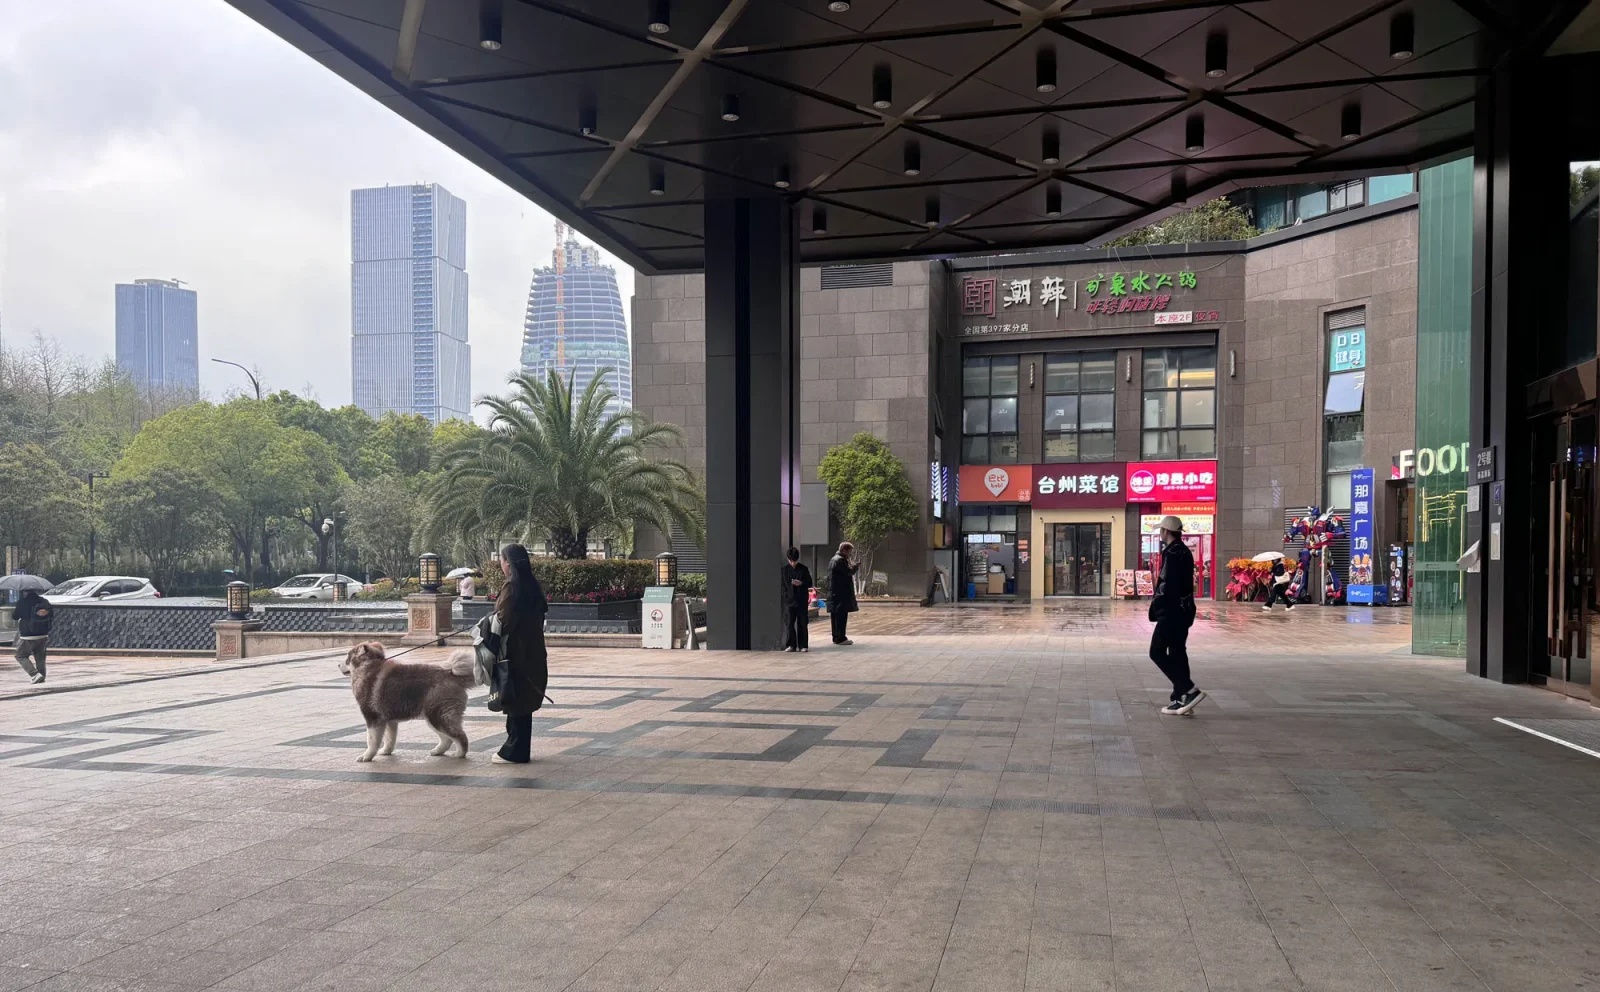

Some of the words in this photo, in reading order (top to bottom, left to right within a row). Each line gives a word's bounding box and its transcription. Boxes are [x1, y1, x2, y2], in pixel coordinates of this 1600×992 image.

[1086, 270, 1198, 297] 矿泉水火锅
[1002, 276, 1068, 319] 潮辣
[1155, 313, 1192, 323] 本座2F
[964, 323, 1029, 335] 全国第397家分店
[1337, 332, 1361, 347] DB
[1335, 350, 1361, 364] 健身
[988, 474, 1006, 482] 巴比
[1037, 474, 1120, 494] 台州菜馆
